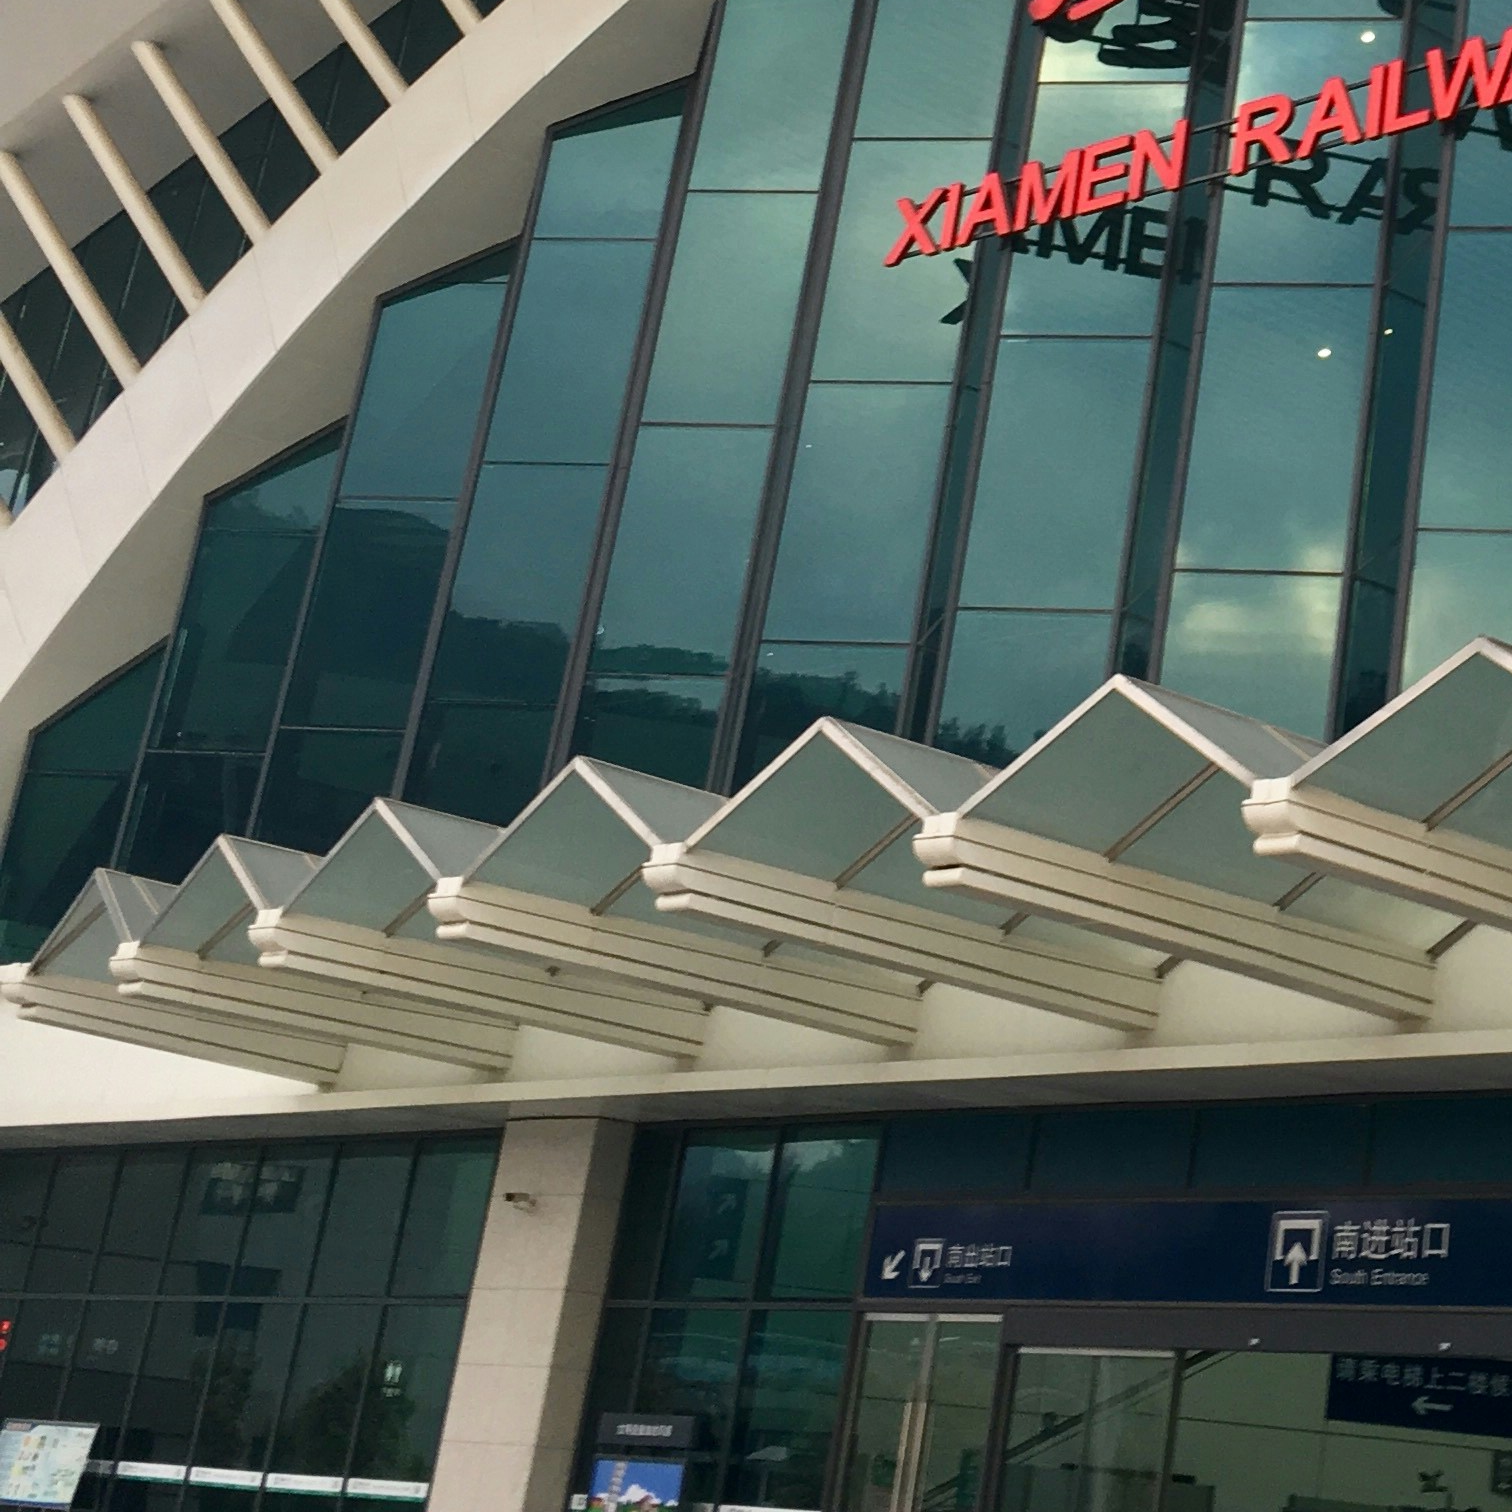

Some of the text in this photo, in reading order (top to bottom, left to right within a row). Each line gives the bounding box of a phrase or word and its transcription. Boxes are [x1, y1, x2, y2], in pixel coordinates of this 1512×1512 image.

[882, 118, 1192, 267] XIAMEN
[1332, 1218, 1450, 1259] 南进站口
